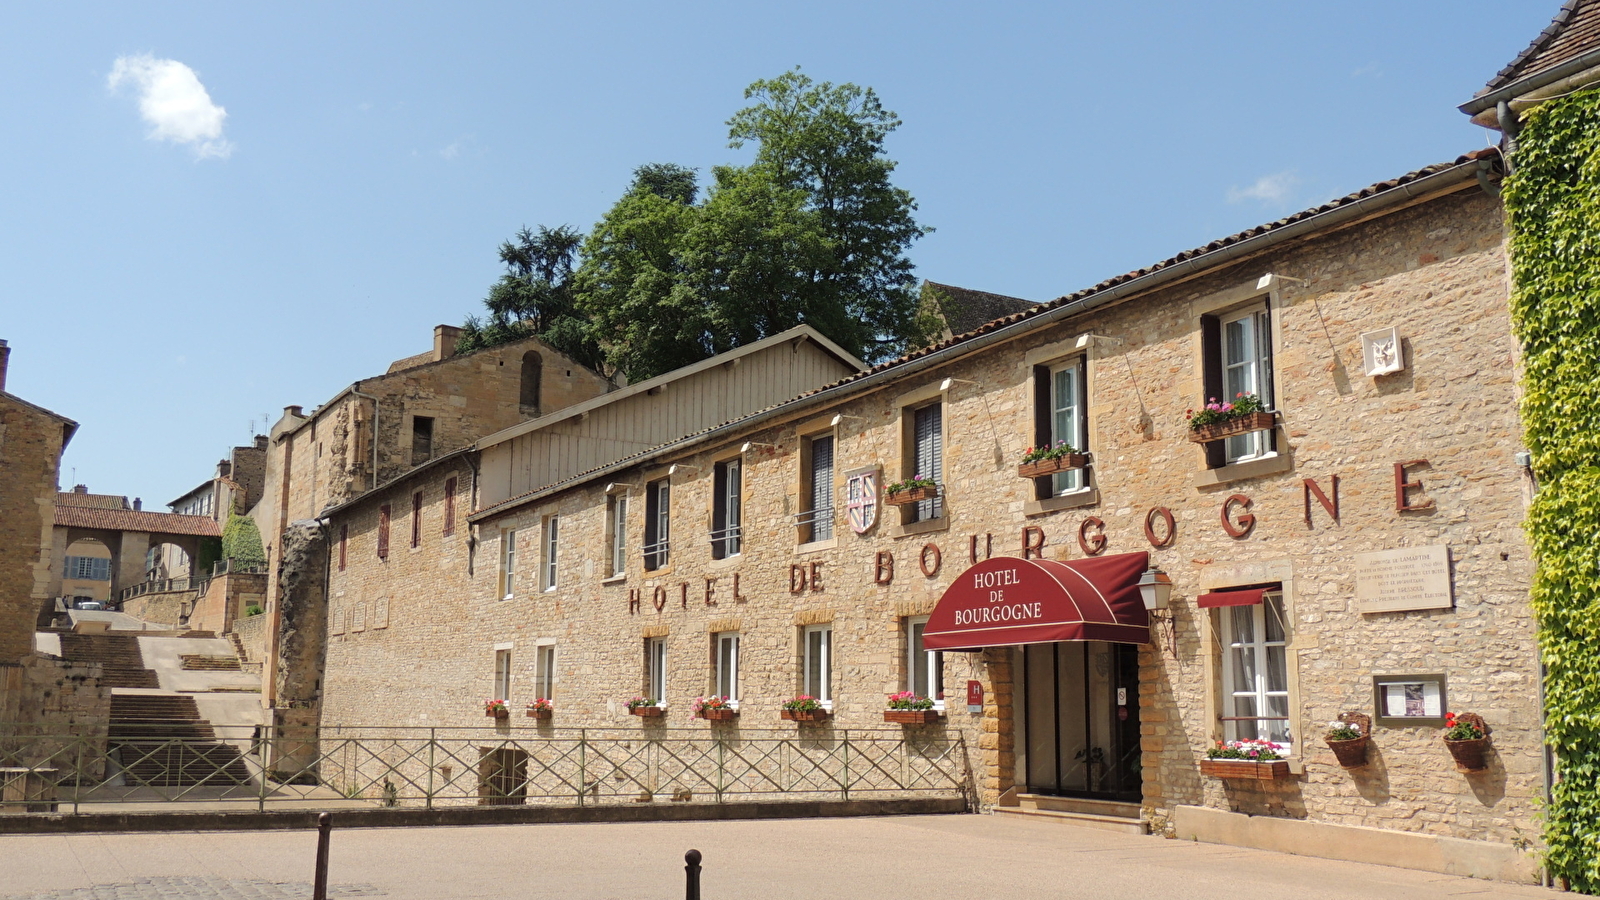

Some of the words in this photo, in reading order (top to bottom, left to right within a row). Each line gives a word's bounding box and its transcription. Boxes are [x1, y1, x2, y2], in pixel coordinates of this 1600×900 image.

[629, 572, 746, 614] HOTEL
[789, 561, 824, 593] DE
[873, 459, 1435, 584] BOURGOGNE
[974, 569, 1020, 589] HOTEL
[990, 590, 1004, 603] DE
[955, 602, 1042, 625] BOURGOGNE
[973, 685, 980, 695] H
